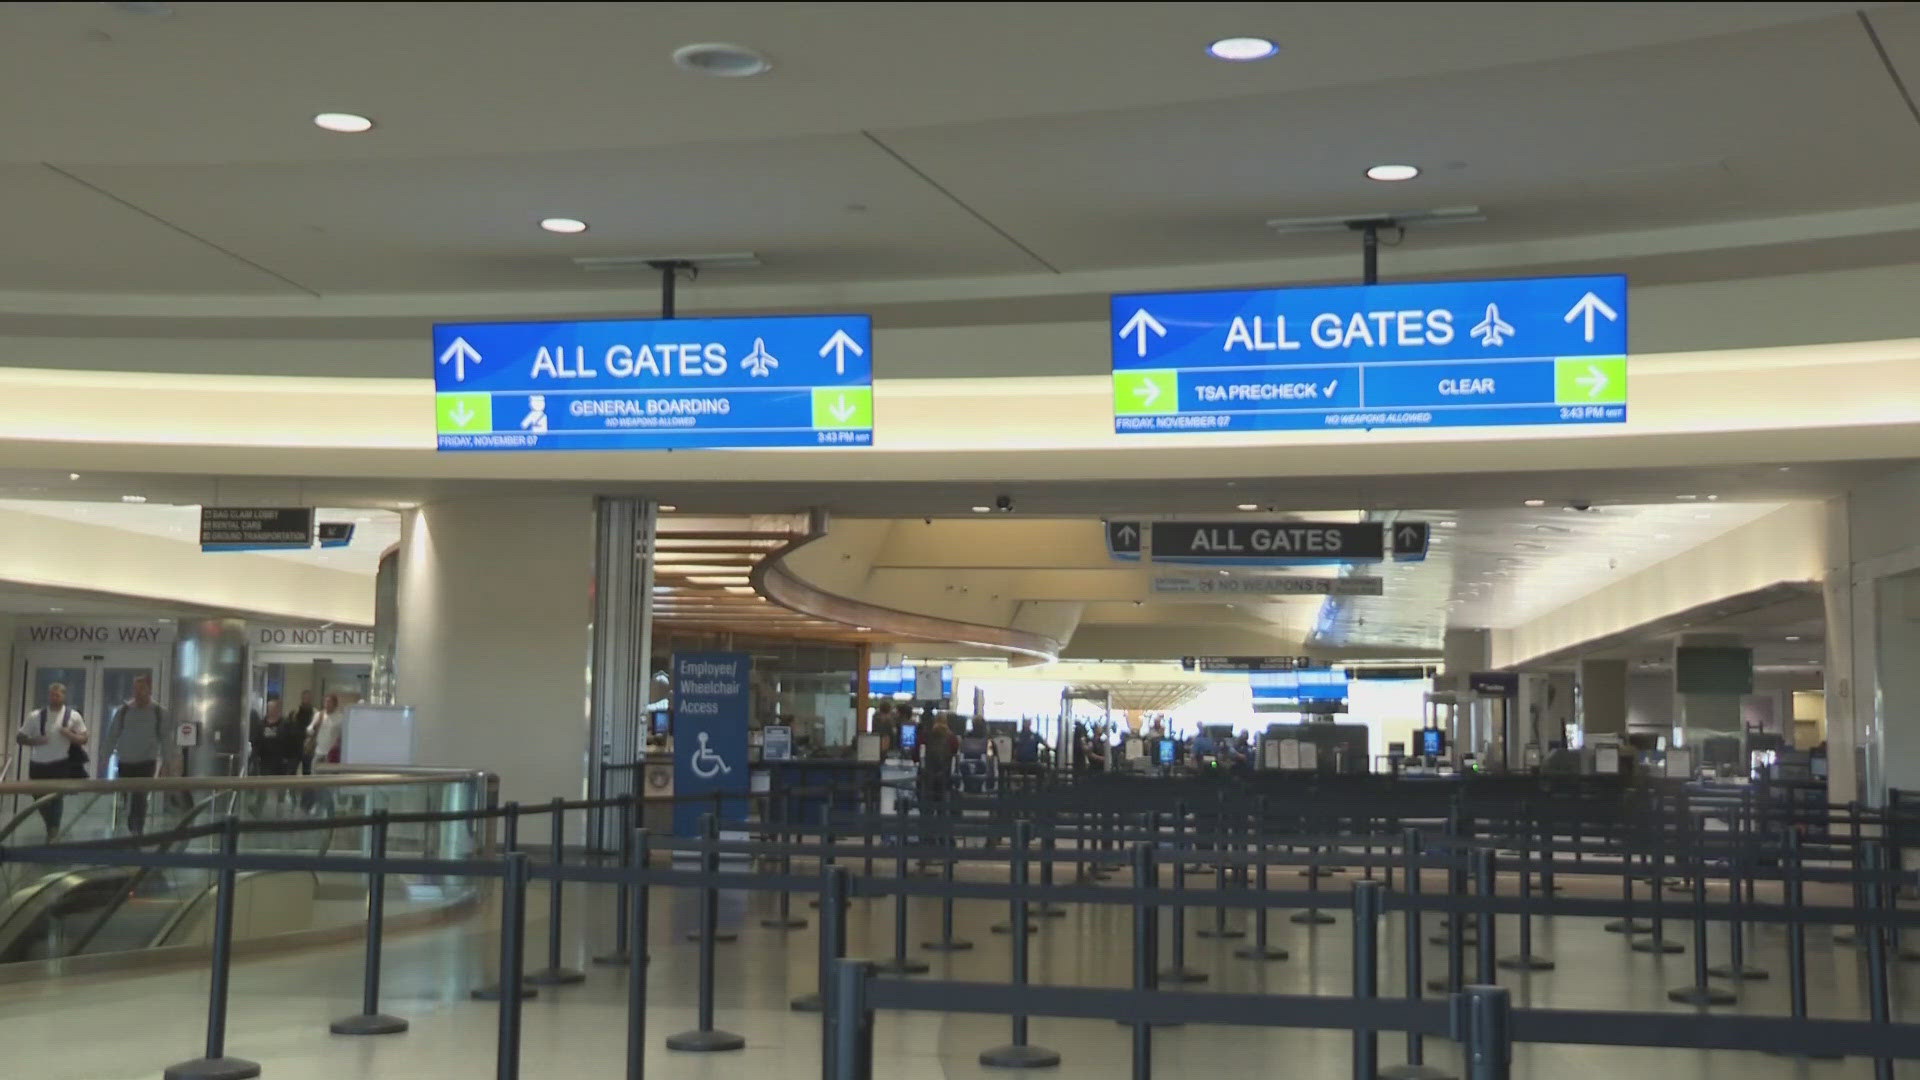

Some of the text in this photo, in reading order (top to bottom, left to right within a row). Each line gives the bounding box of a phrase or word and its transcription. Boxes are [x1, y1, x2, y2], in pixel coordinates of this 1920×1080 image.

[1223, 308, 1455, 352] ALL GATES
[530, 342, 728, 379] ALL GATES
[1195, 382, 1317, 402] TSA PRECHECK
[1438, 378, 1496, 396] CLEAR
[570, 397, 730, 416] GENERAL BOARDING
[1560, 408, 1583, 419] 3:43
[1585, 407, 1604, 418] PM
[605, 417, 696, 427] NO WEAPONS ALLOWED
[1115, 415, 1230, 429] FRIDAY, NOVEMBER 07
[1325, 412, 1432, 424] NO WEAPONS ALLOWED
[440, 435, 538, 447] FRIDAY, NOVEMBER 07
[817, 432, 836, 443] 3:43
[838, 432, 854, 443] PM
[230, 510, 253, 519] CLAIM
[212, 520, 262, 529] RENTAL CARS
[244, 530, 306, 540] TRANSPORTATION
[1191, 529, 1342, 551] ALL GATES
[1218, 578, 1313, 591] NO WEAPONS
[30, 626, 161, 641] WRONG WAY
[260, 628, 375, 644] DO NOT ENTE
[680, 660, 737, 678] Employee/
[680, 680, 740, 694] Wheelchair
[680, 699, 719, 714] Access
